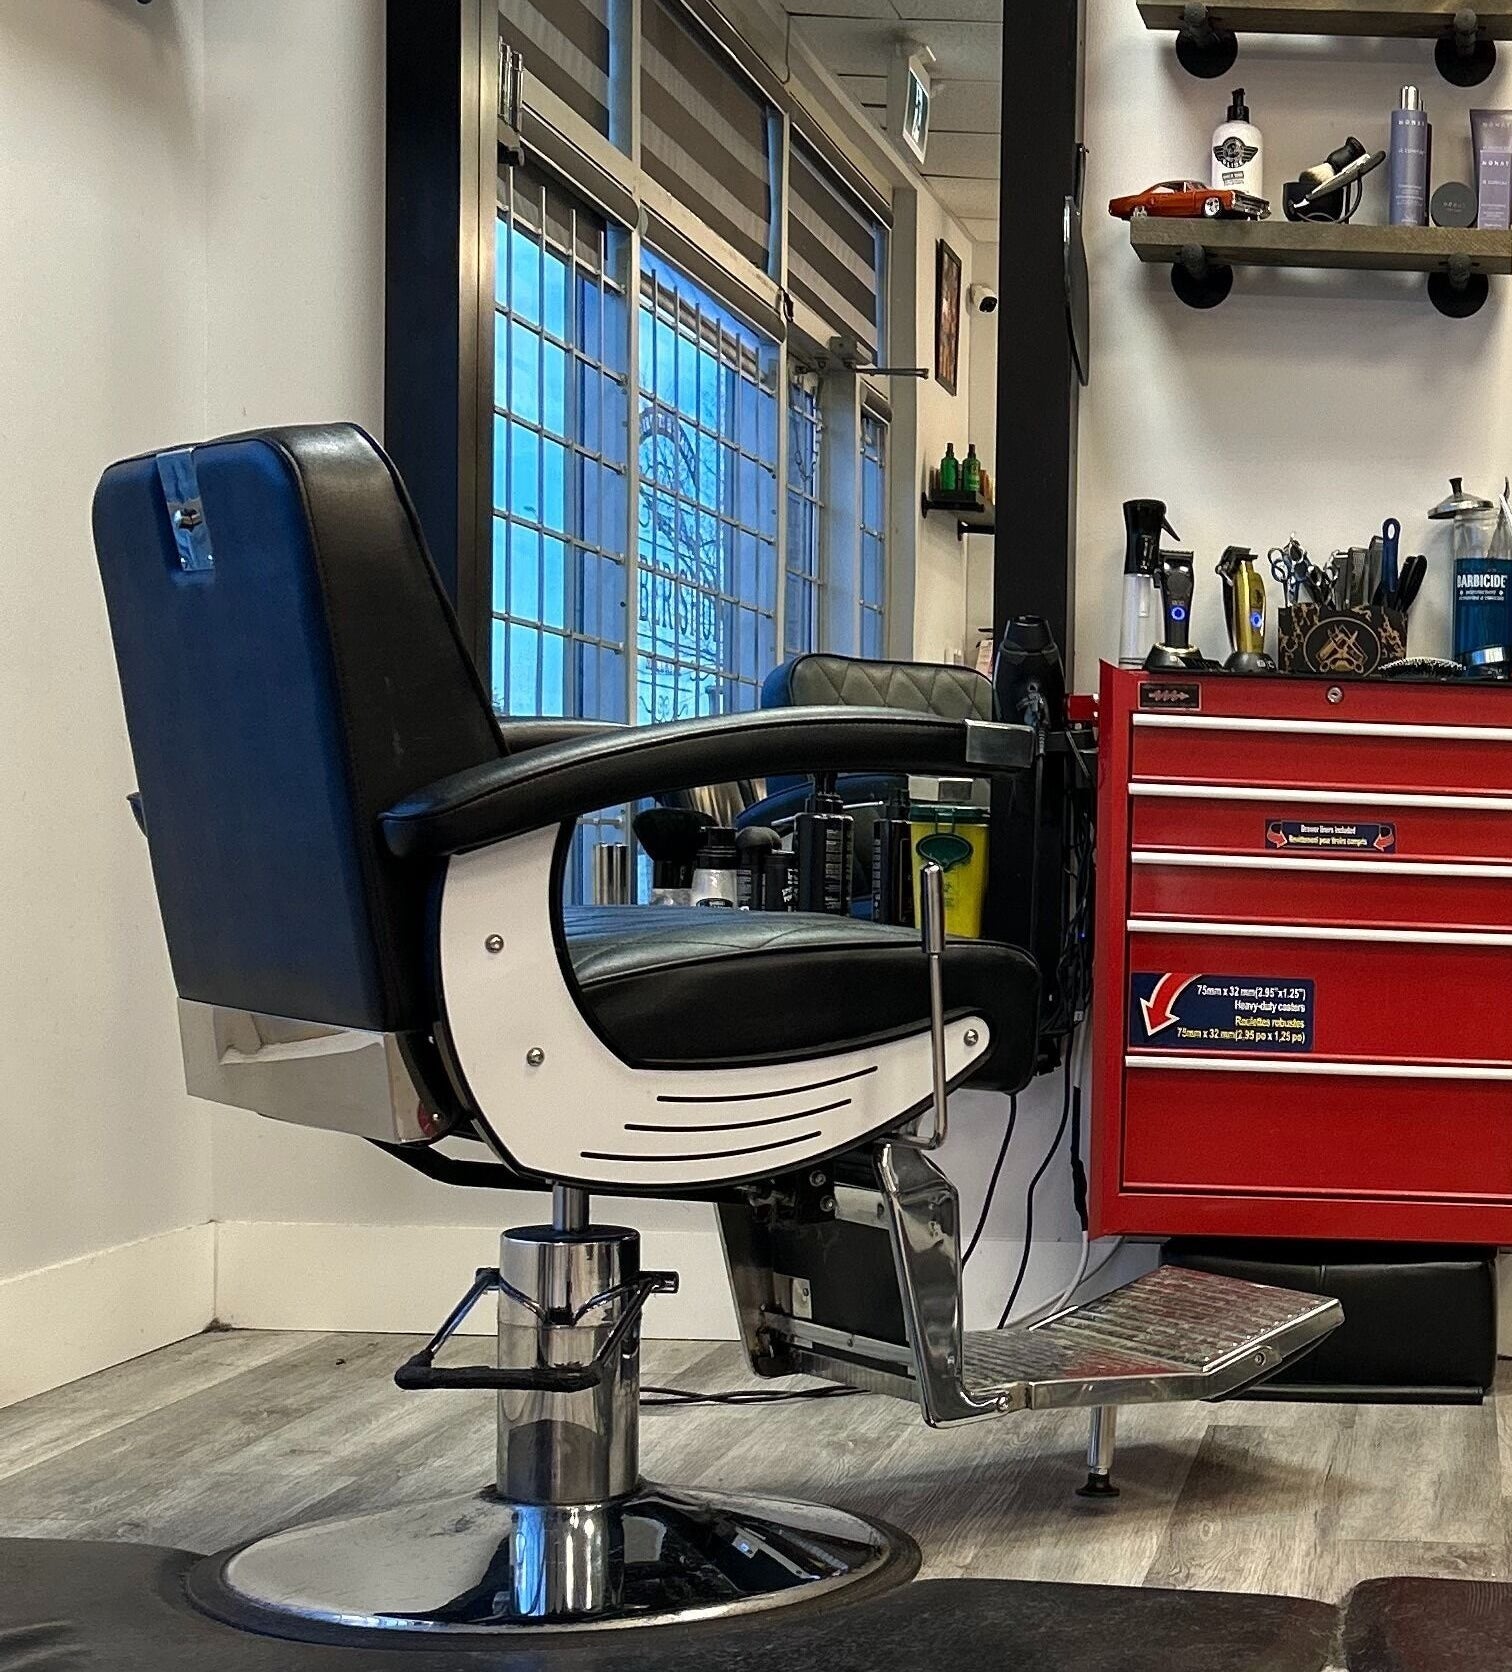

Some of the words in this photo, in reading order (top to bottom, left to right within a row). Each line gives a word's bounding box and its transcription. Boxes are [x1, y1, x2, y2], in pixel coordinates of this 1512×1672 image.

[1197, 984, 1221, 996] 75mm
[1223, 987, 1228, 996] x
[1229, 986, 1239, 997] 32
[1235, 1000, 1277, 1014] Heavy-duty
[1235, 1015, 1271, 1028] Roulettes
[1272, 1017, 1305, 1029] robustes
[1177, 1027, 1201, 1038] 75mm
[1202, 1030, 1209, 1038] x
[1209, 1027, 1219, 1039] 32
[1256, 1031, 1266, 1041] po
[1292, 1032, 1306, 1044] po)
